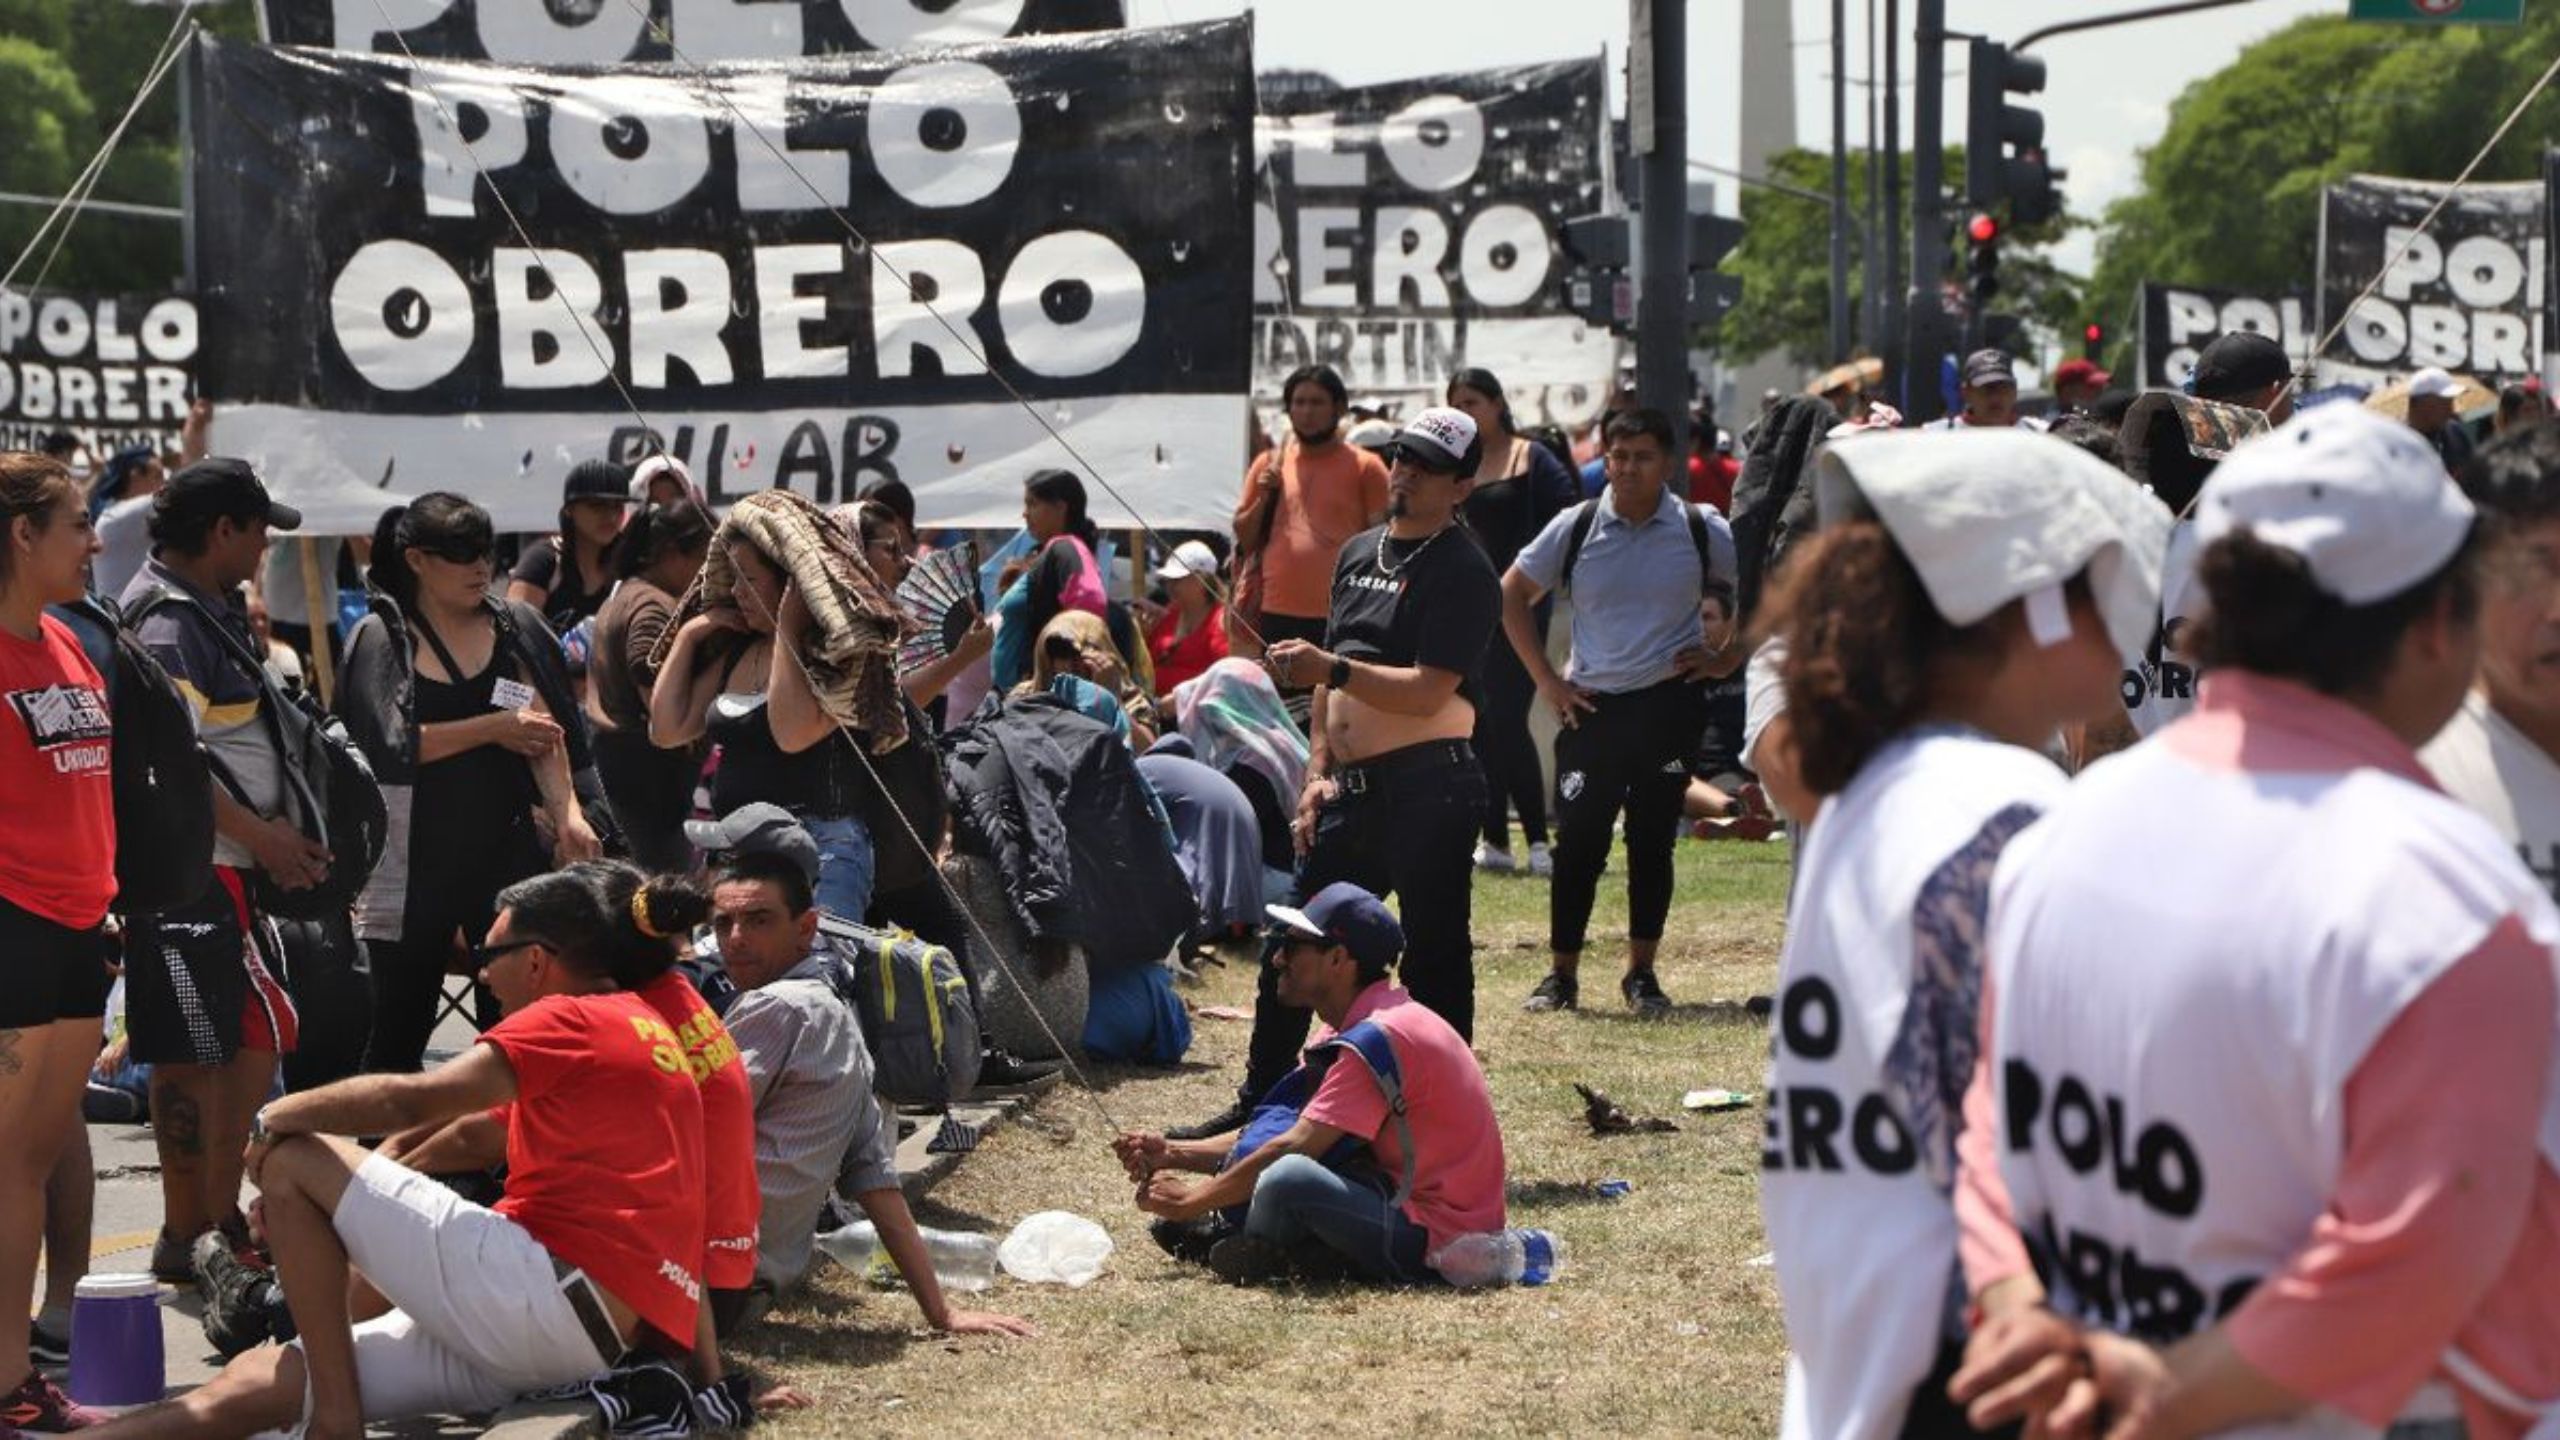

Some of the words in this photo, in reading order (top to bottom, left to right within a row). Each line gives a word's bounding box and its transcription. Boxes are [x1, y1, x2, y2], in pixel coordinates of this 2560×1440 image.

[408, 58, 1022, 217] POLO
[1254, 93, 1484, 192] LO
[0, 287, 199, 362] POLO
[331, 229, 1146, 391] OBRERO
[1252, 317, 1468, 388] ARTIN
[2345, 297, 2543, 374] OBR
[0, 359, 199, 421] BRER
[1770, 973, 1842, 1063] O
[2004, 1057, 2208, 1221] POLO
